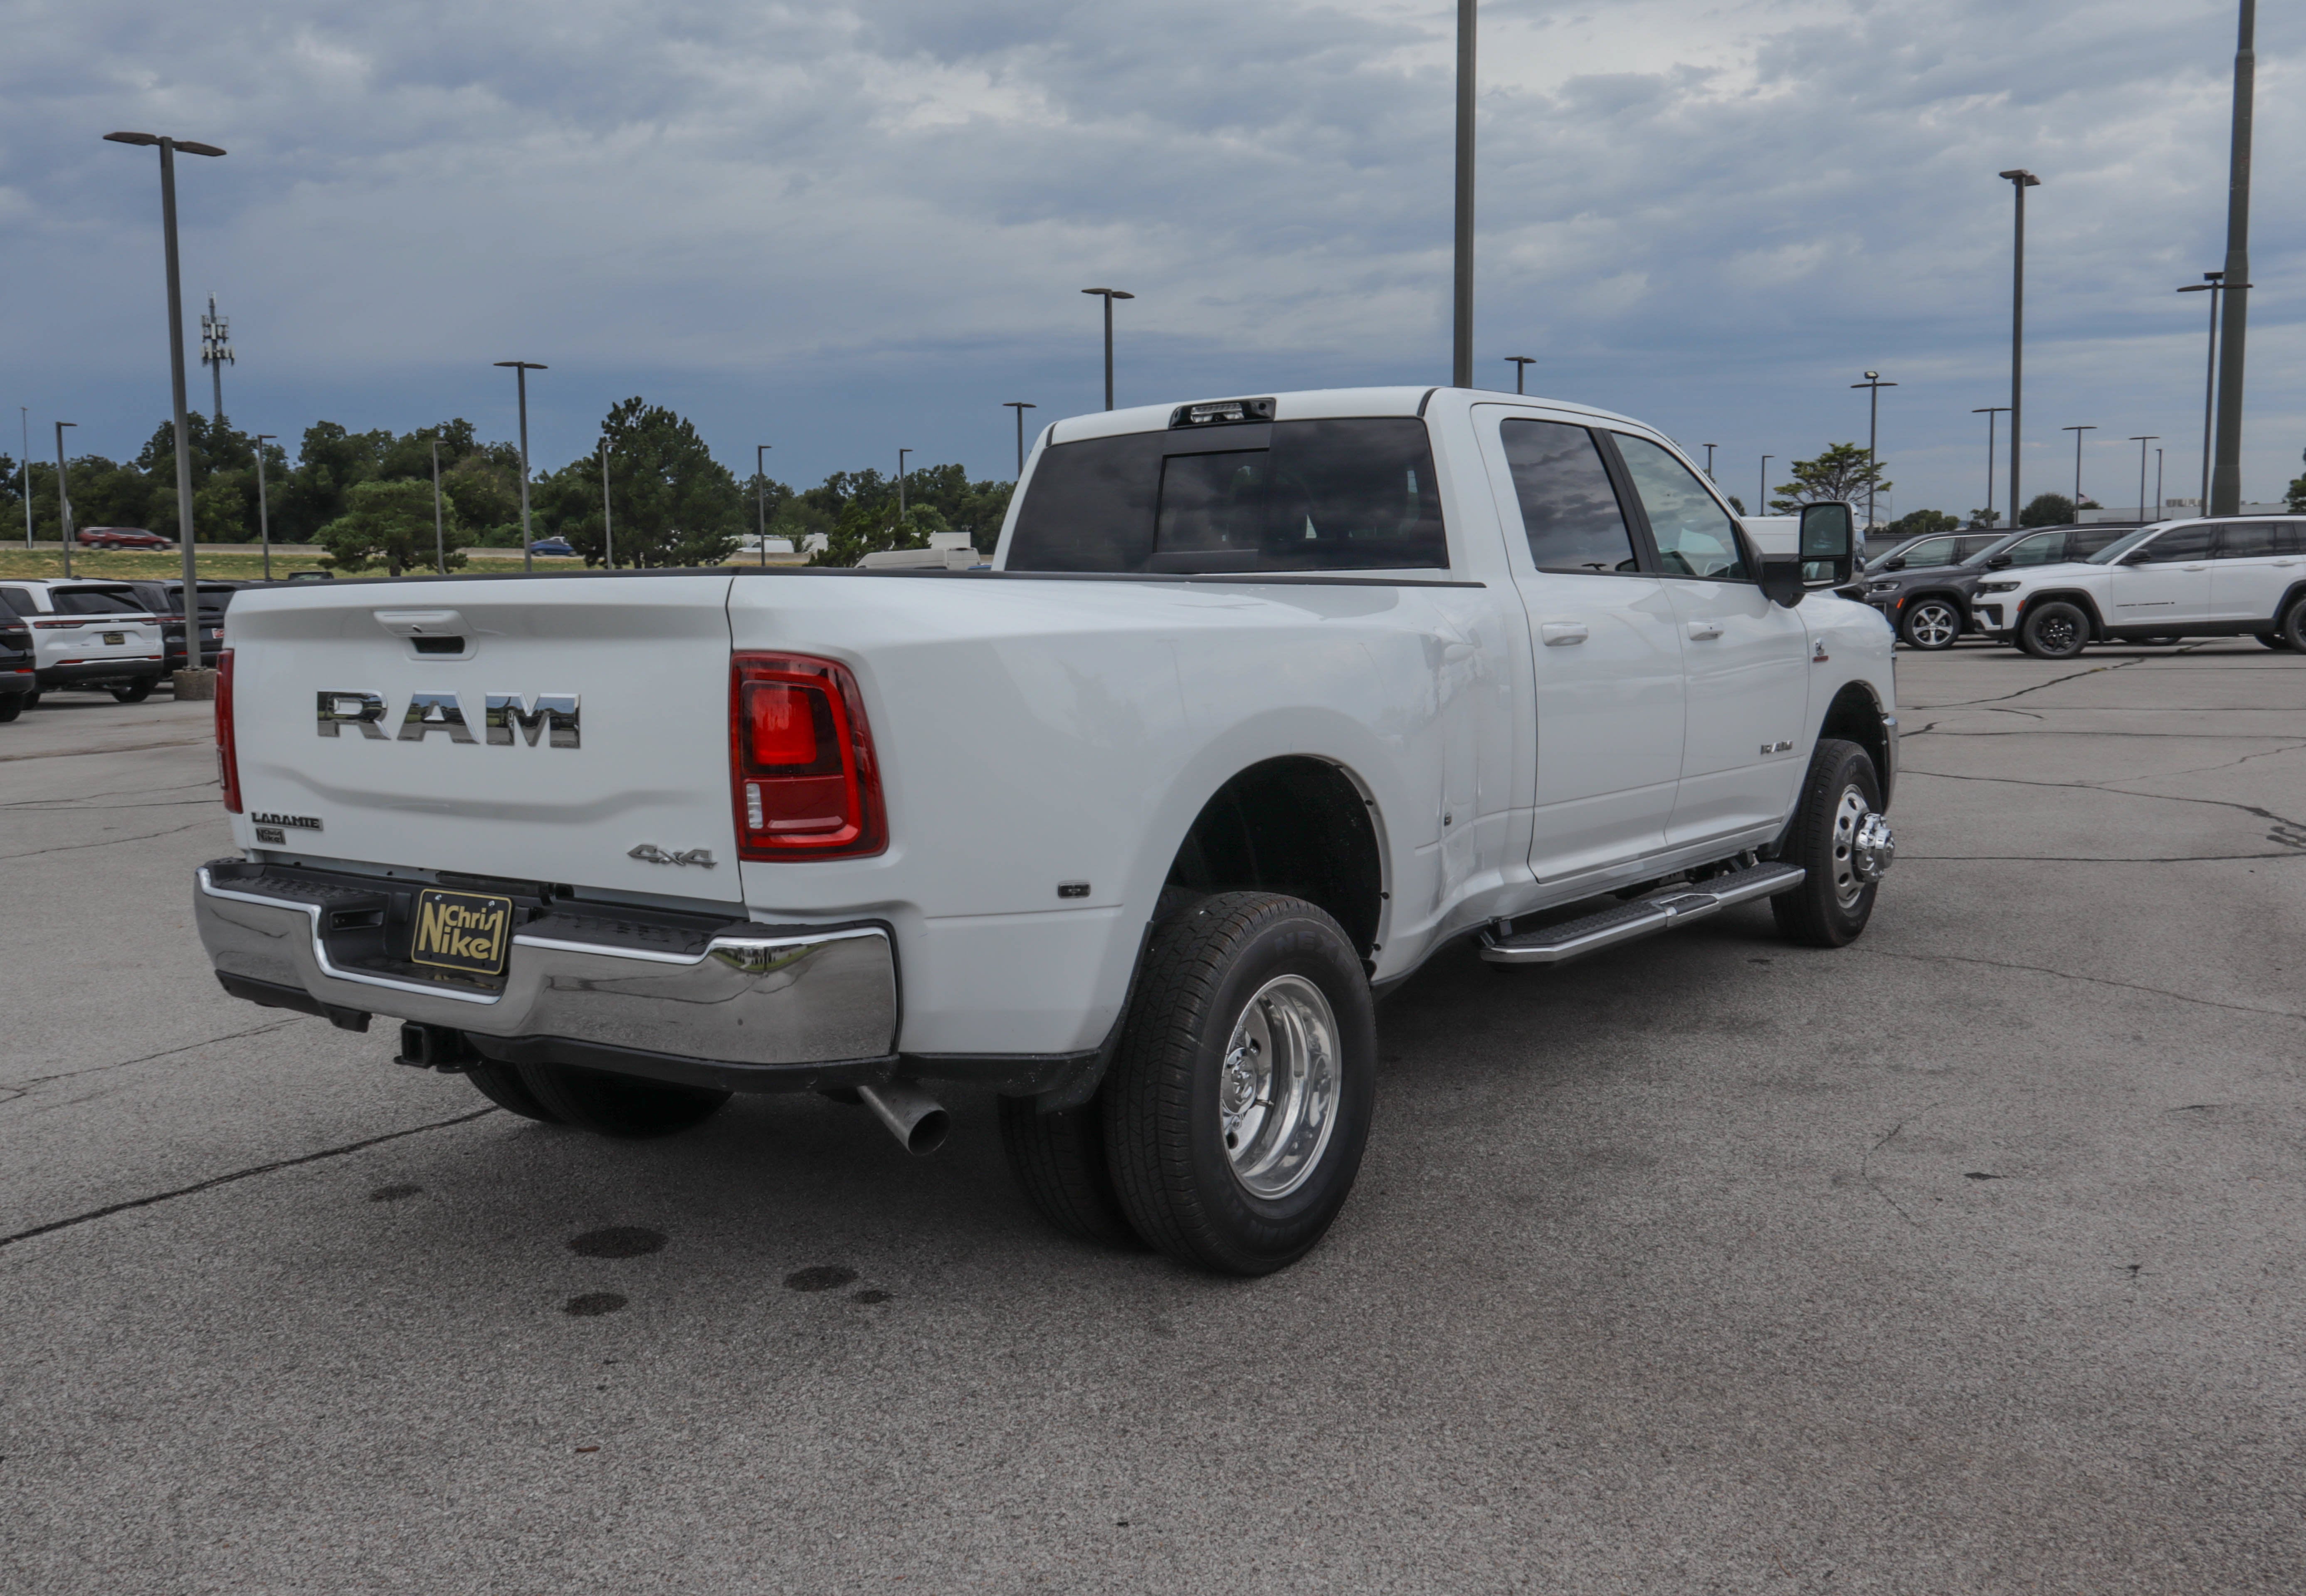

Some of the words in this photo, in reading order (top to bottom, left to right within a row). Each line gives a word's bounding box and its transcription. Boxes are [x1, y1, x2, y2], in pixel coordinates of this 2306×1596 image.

[317, 689, 581, 749] RAM
[251, 812, 321, 829] LARAMIE
[418, 902, 504, 961] Nikel
[444, 905, 498, 931] Chris
